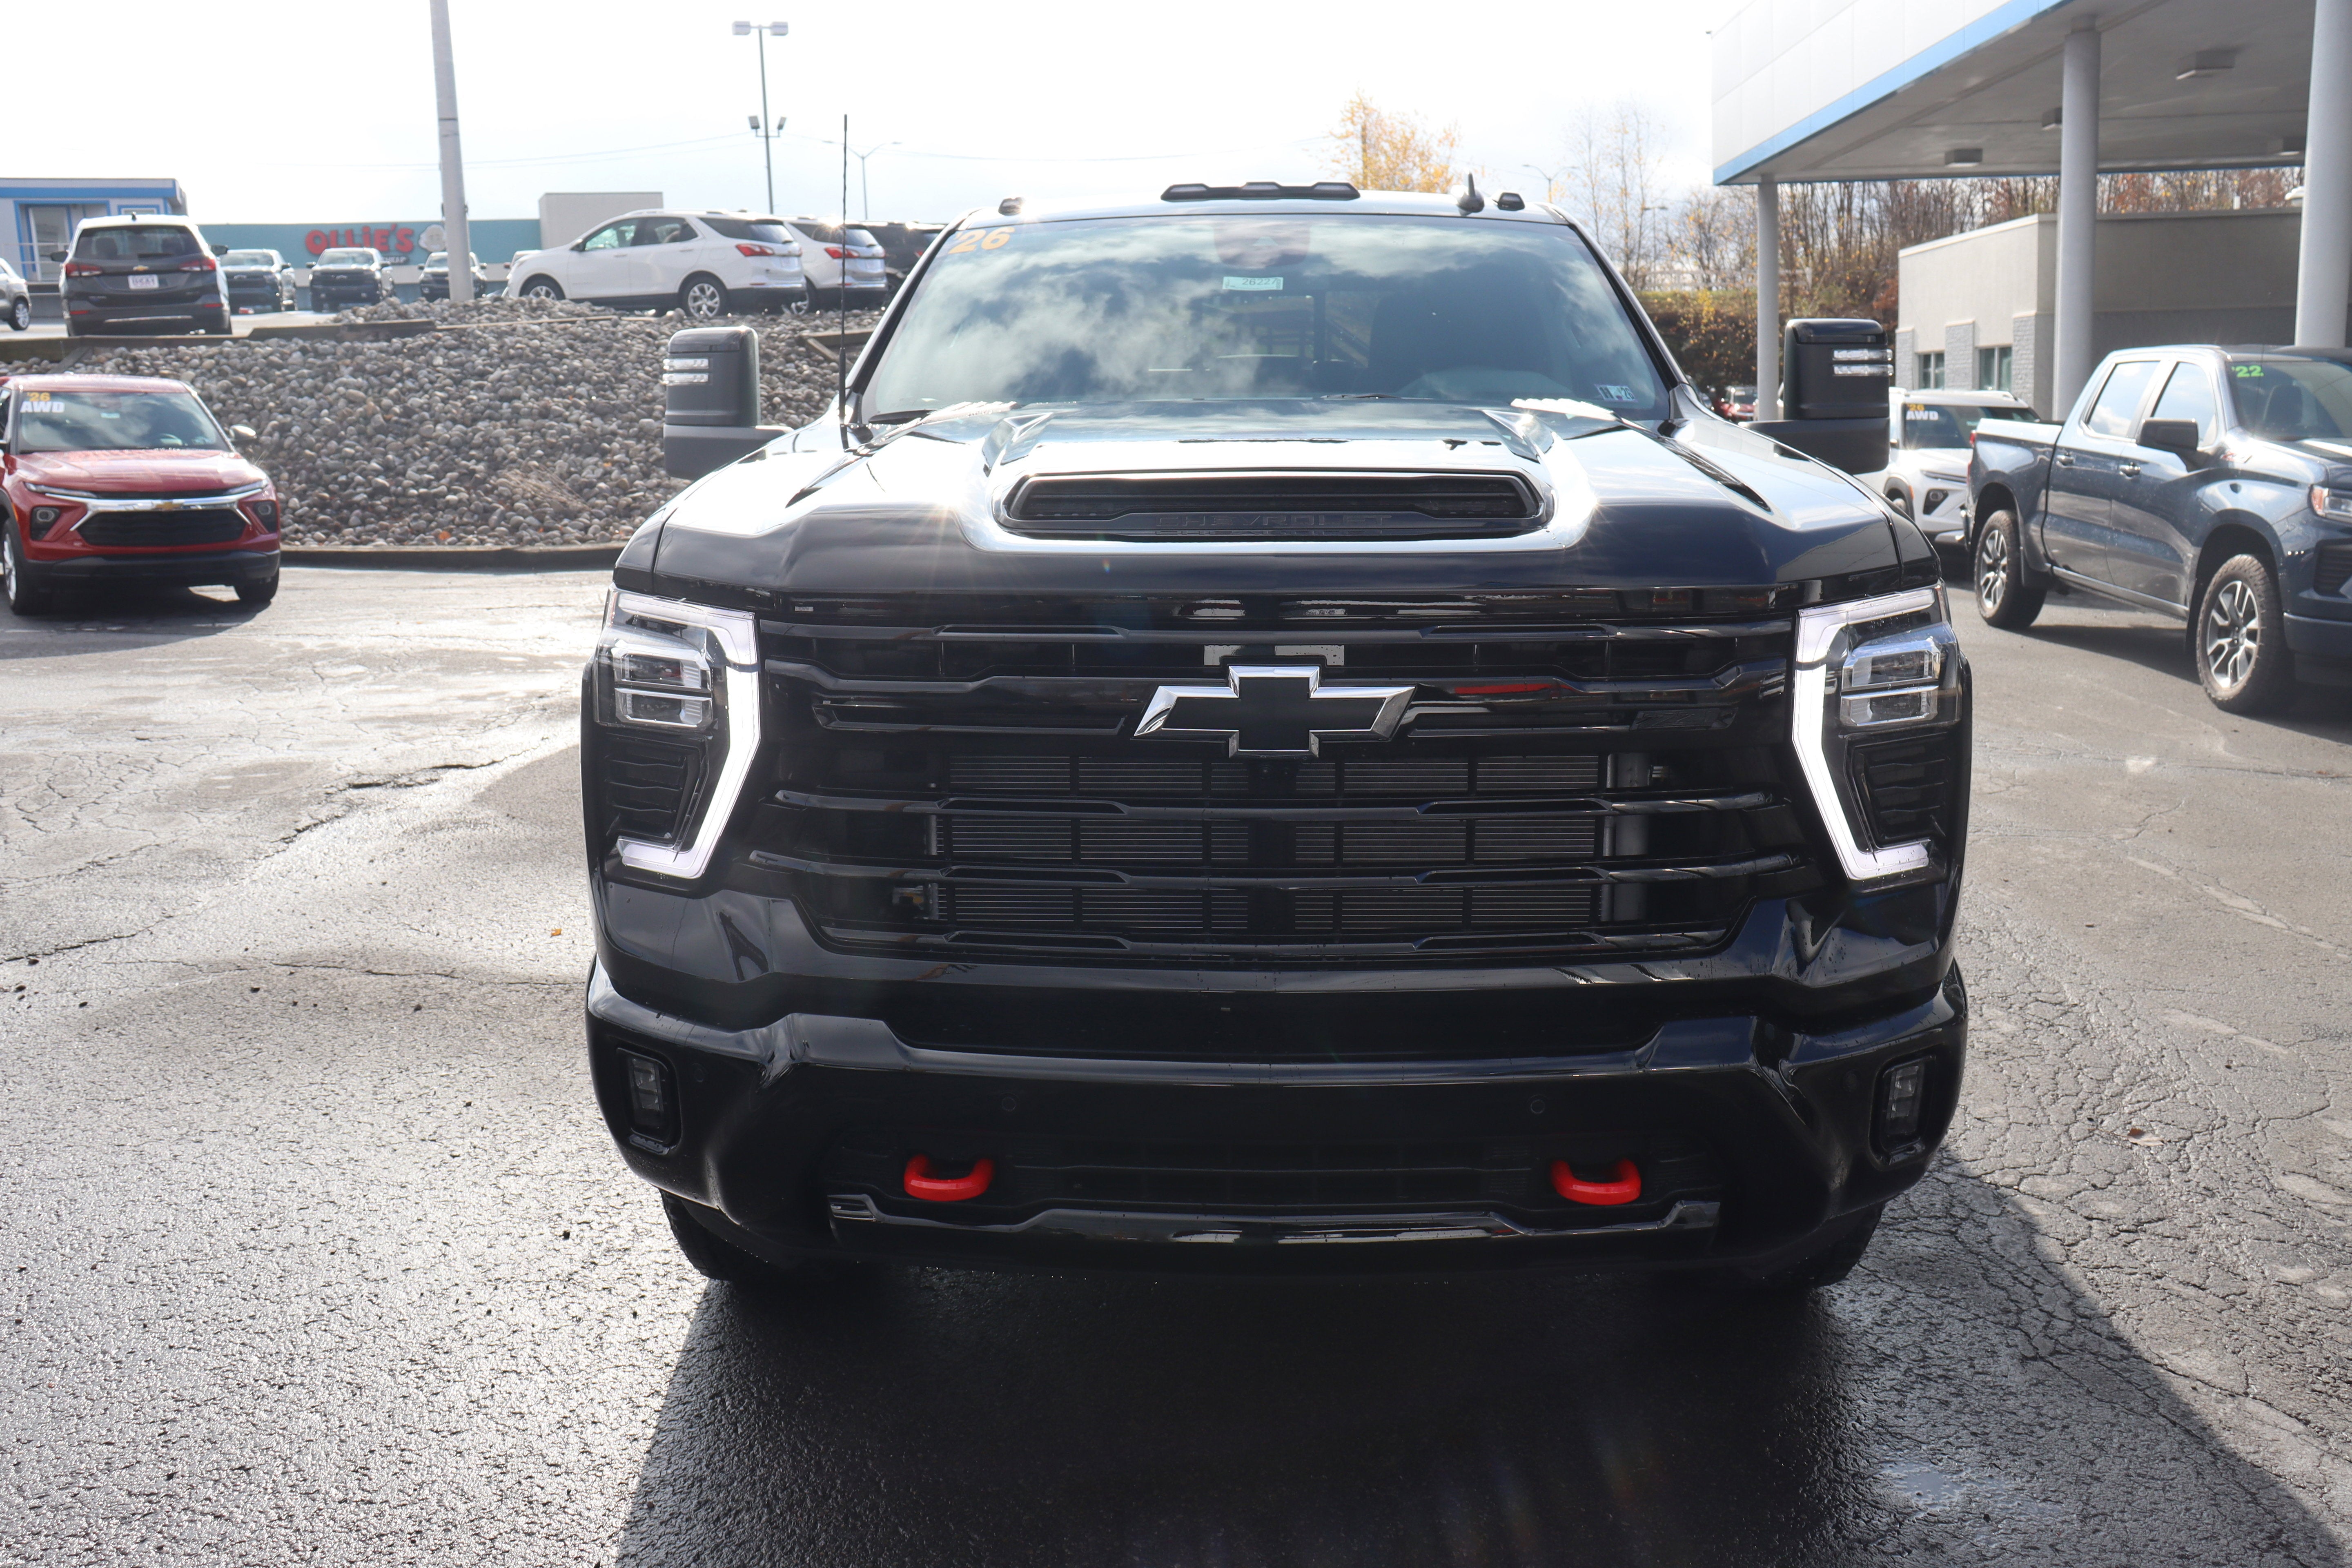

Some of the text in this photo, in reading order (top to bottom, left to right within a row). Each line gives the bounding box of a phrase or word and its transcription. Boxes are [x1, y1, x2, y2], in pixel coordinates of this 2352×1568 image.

[948, 227, 1016, 254] '26
[1620, 387, 1635, 399] 26
[20, 401, 65, 413] AWD
[1906, 410, 1939, 421] AWD
[1156, 514, 1392, 526] CHEVROLET
